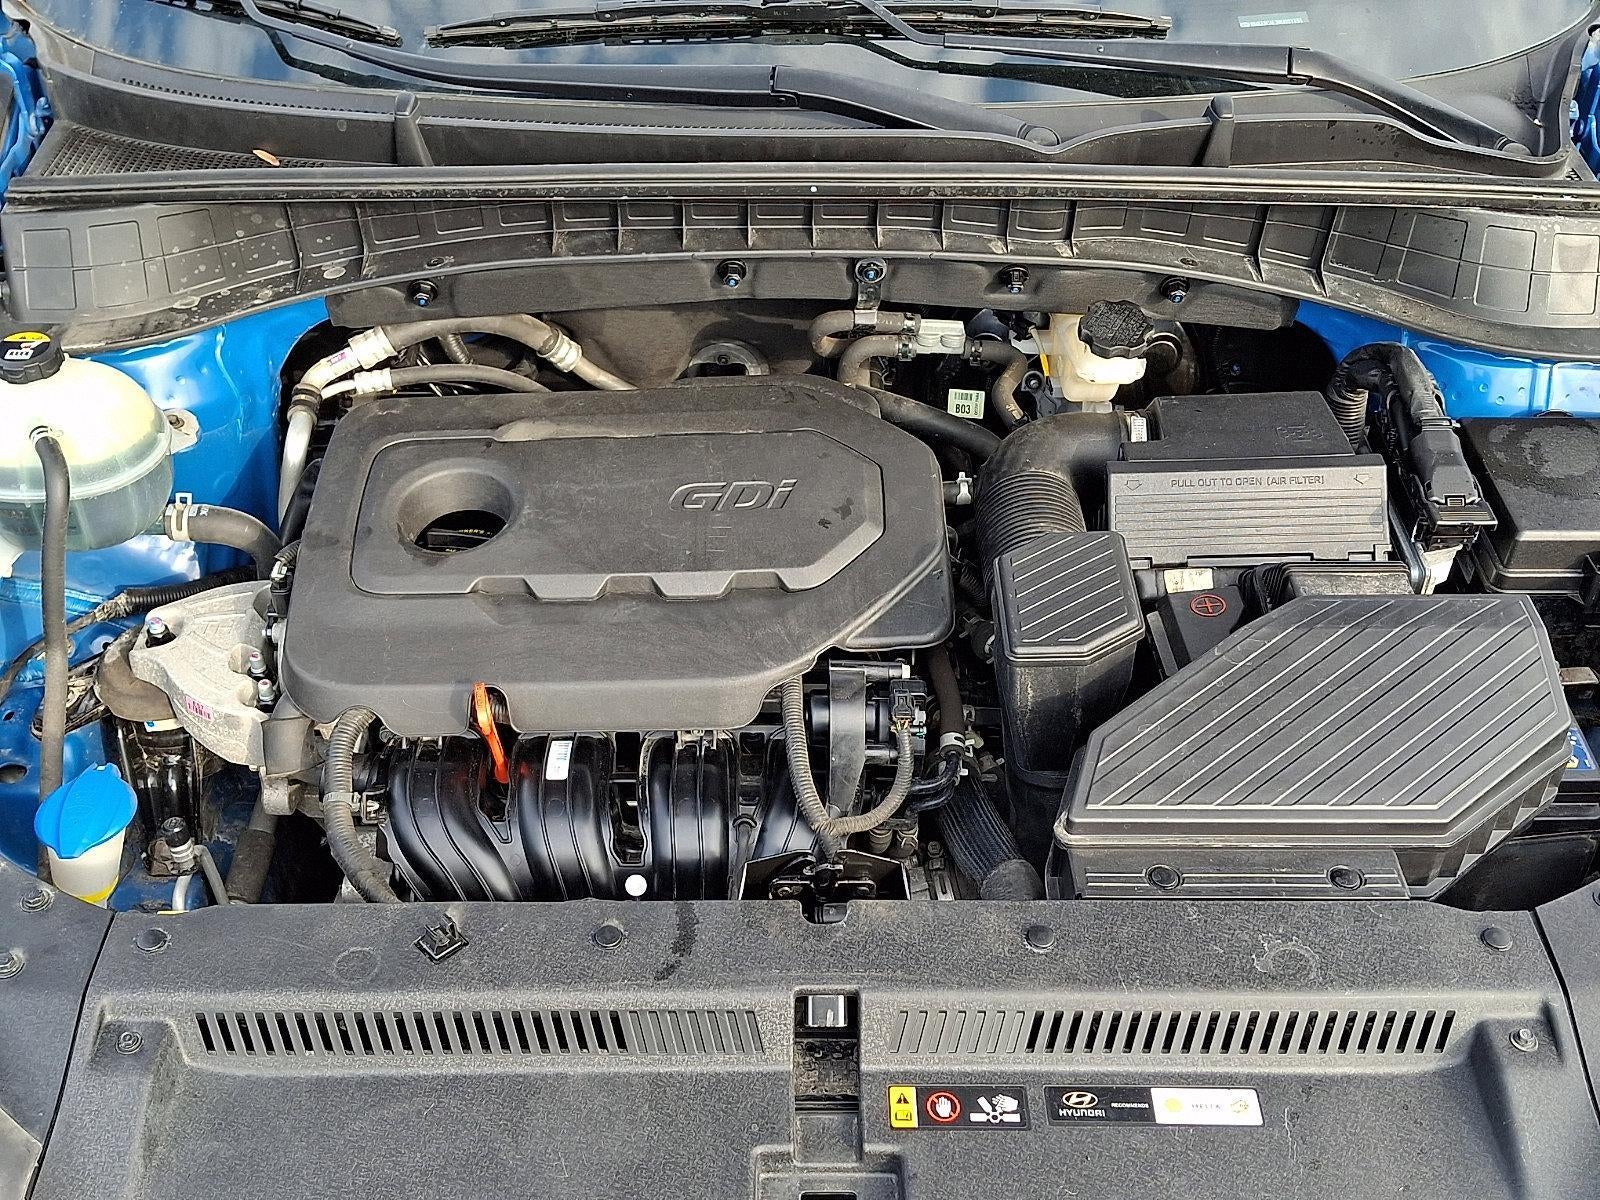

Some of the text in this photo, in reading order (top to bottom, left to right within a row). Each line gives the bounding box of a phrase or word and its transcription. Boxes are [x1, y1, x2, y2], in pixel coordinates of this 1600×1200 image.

[955, 404, 971, 414] B03
[1171, 479, 1195, 487] PULL
[1197, 478, 1217, 486] OUT
[1220, 477, 1232, 486] TO
[1235, 476, 1262, 486] OPEN
[668, 479, 798, 511] GDi
[1058, 1108, 1106, 1117] HYUNDAI
